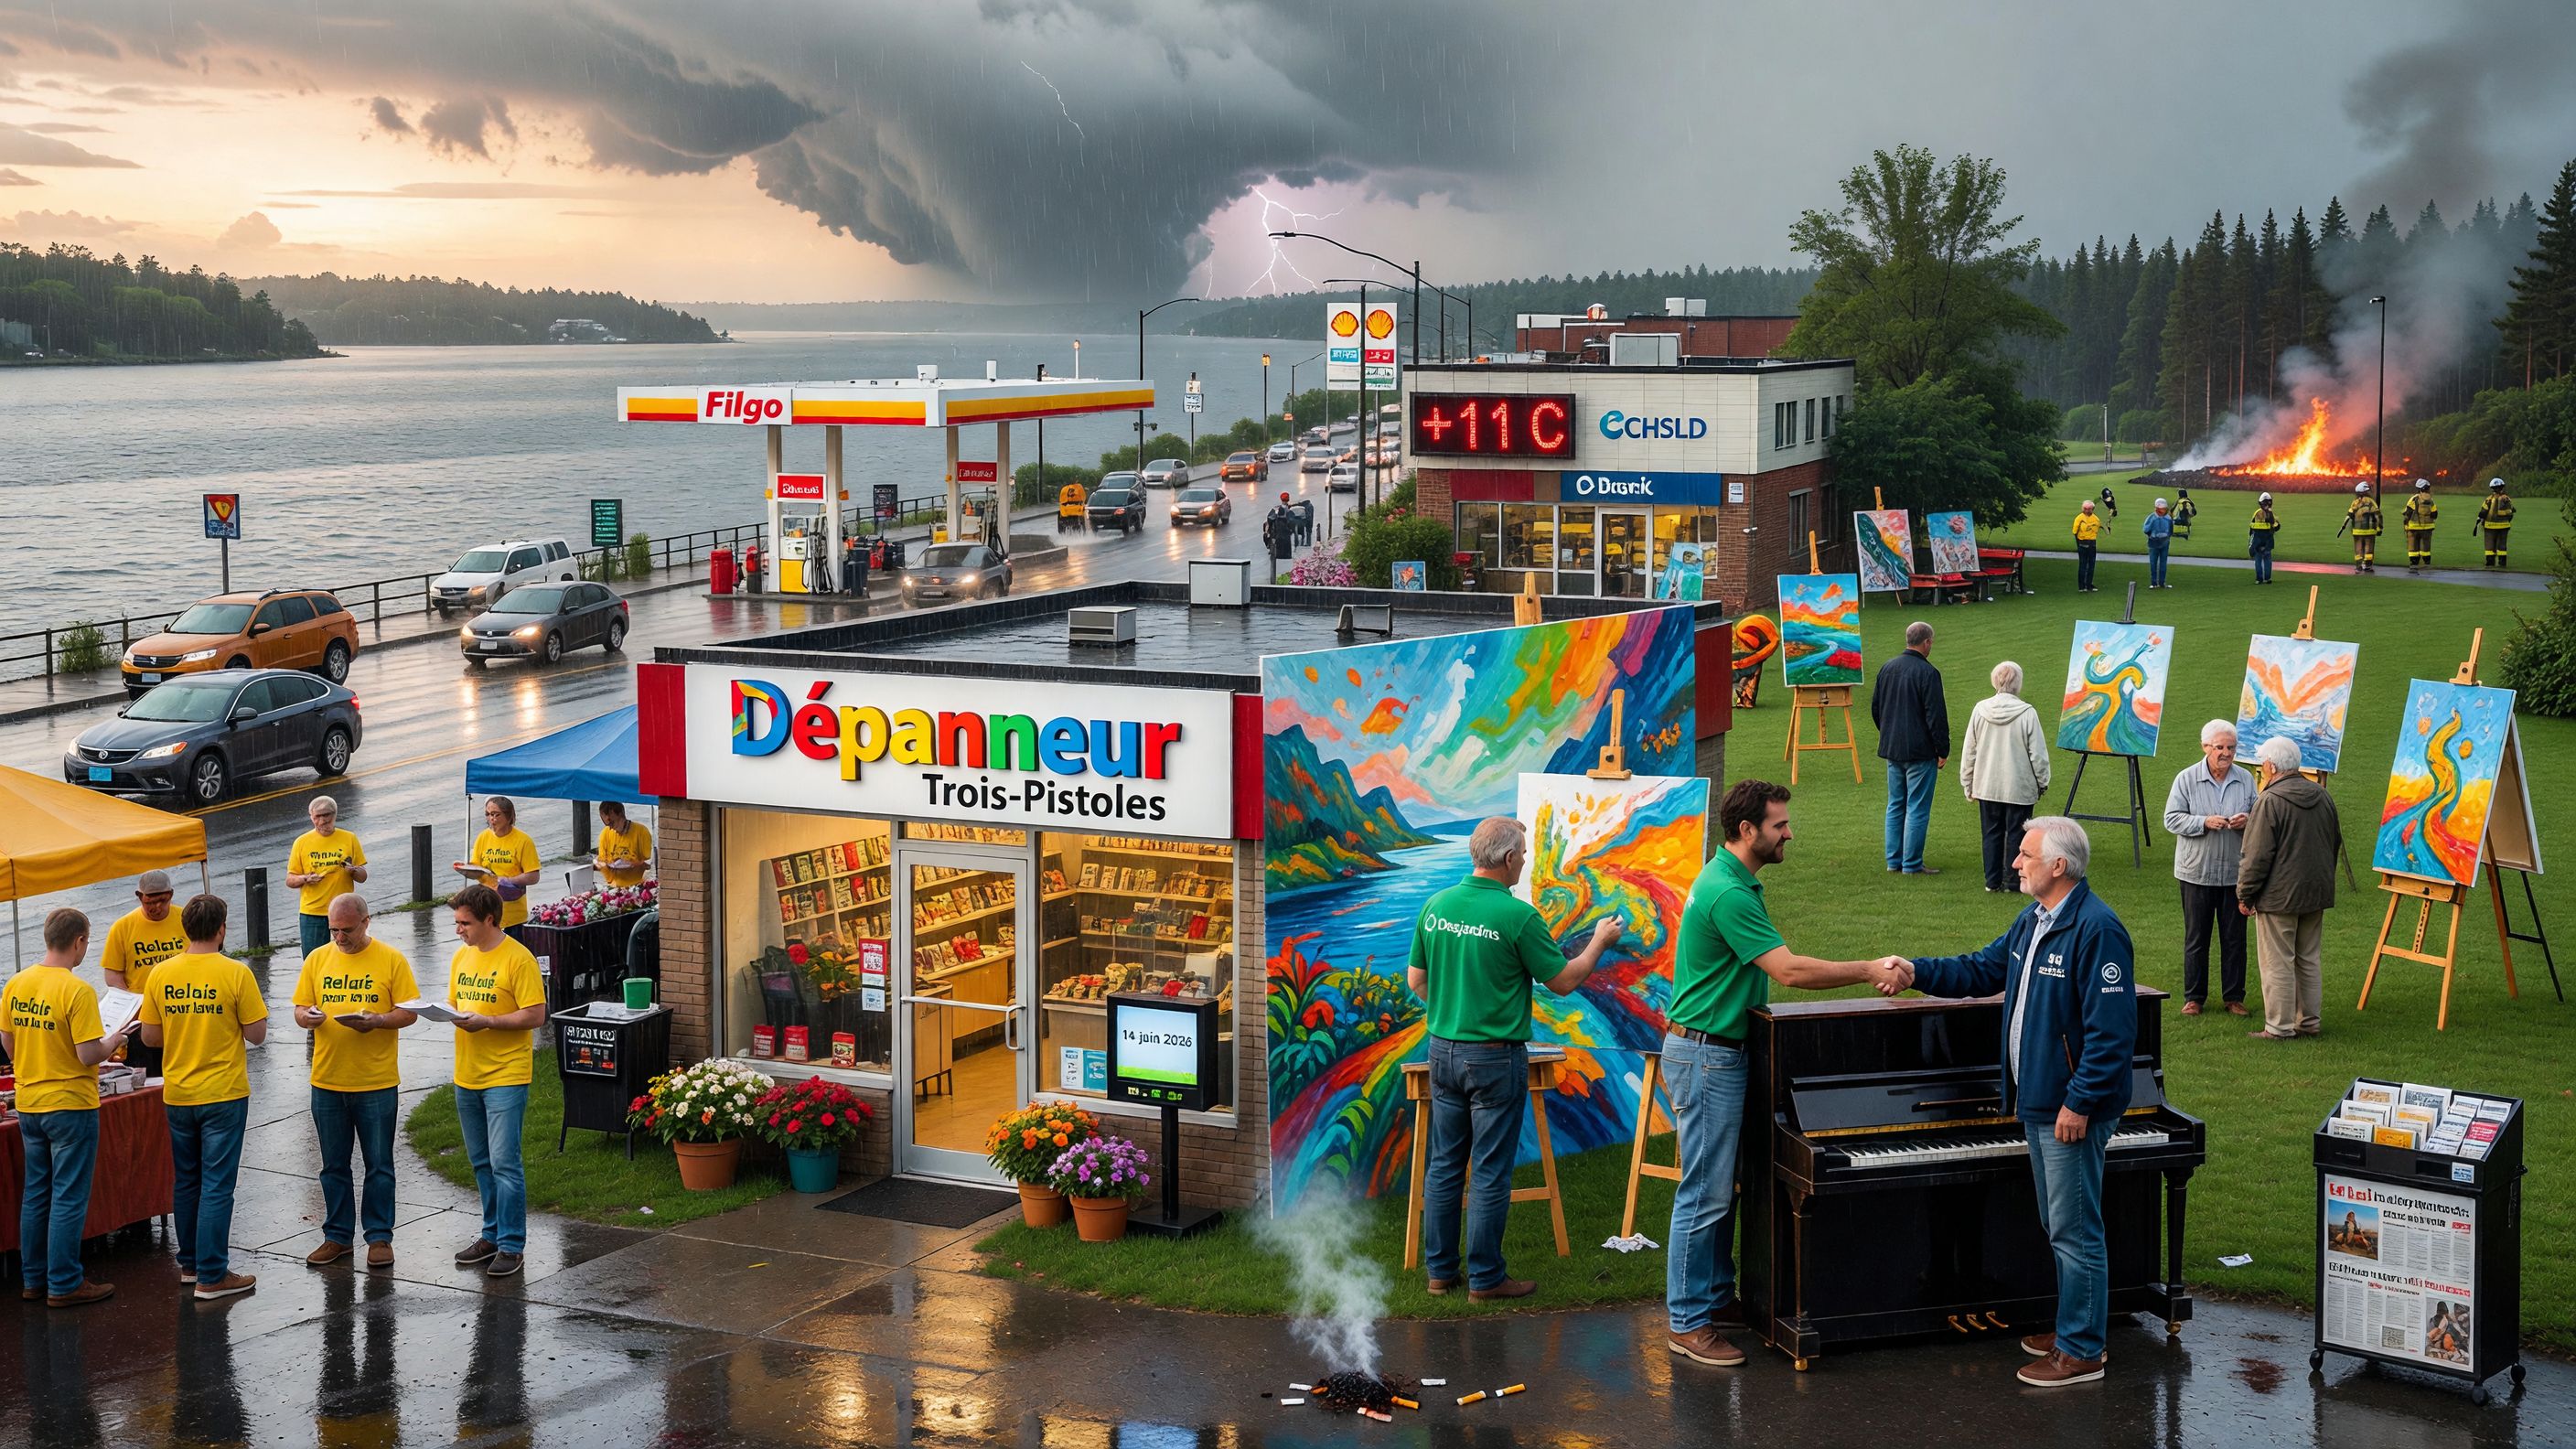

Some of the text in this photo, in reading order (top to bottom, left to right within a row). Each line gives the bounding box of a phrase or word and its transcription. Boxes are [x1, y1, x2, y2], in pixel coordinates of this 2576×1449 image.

[705, 391, 783, 424] Filgo
[1422, 402, 1564, 449] +11 C
[1625, 417, 1707, 439] CHSLD
[731, 679, 1182, 781] Dépanneur
[922, 773, 1165, 821] Trois-Pistoles
[165, 983, 217, 1000] Relais
[1122, 1029, 1192, 1047] 14 juin 2026
